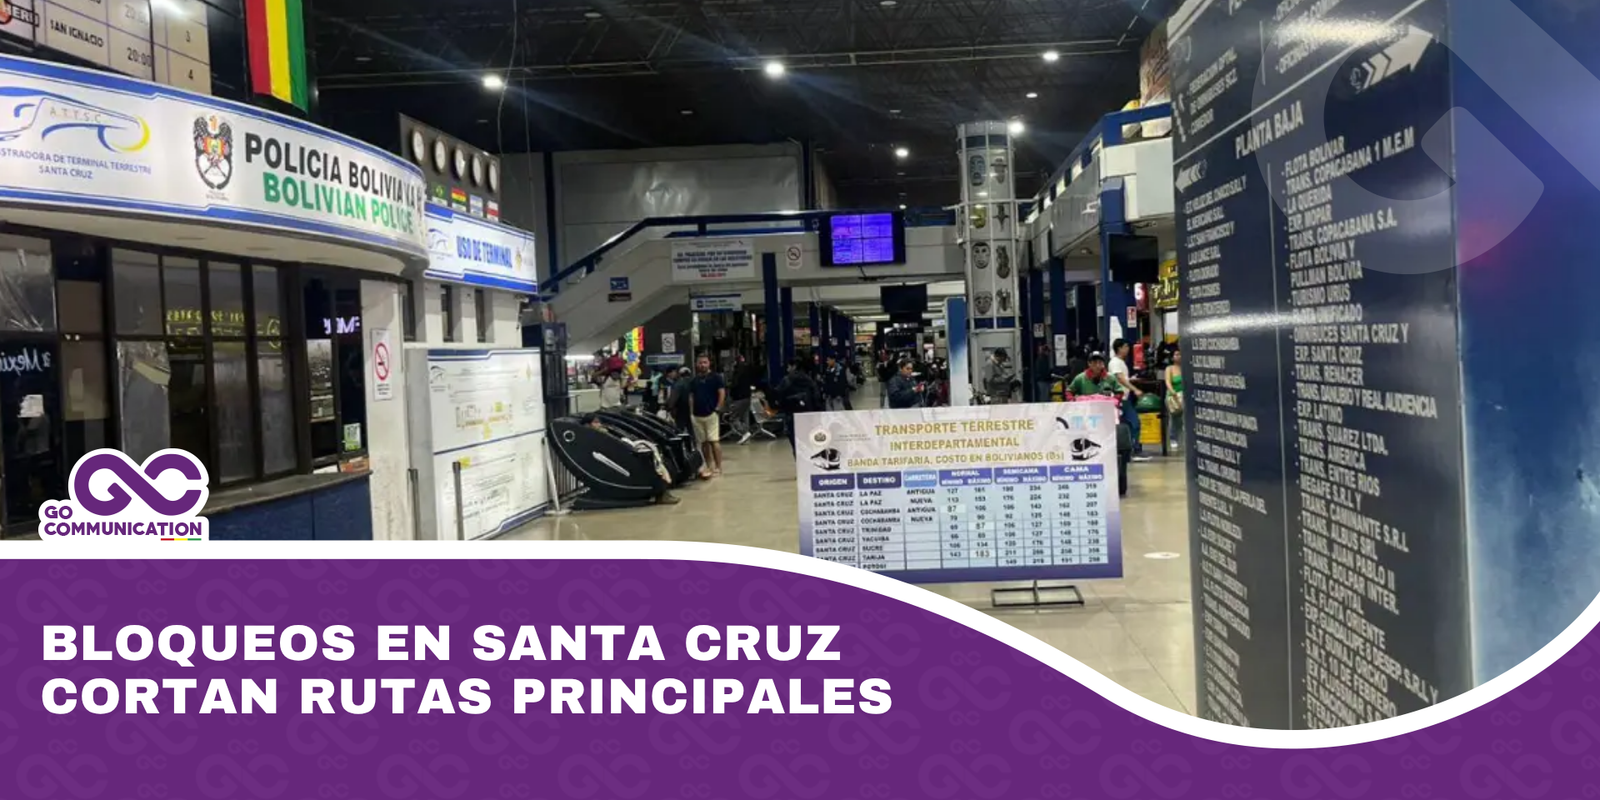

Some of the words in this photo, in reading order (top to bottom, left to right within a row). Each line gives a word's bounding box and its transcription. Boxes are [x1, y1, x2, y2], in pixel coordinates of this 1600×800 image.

[50, 19, 67, 35] SAN
[69, 26, 104, 48] IGNACIO
[188, 69, 194, 80] 4
[1235, 118, 1273, 159] PLANTA
[1273, 100, 1304, 139] BAJA
[0, 147, 51, 162] STRADORA
[53, 153, 66, 164] DE
[67, 155, 109, 170] TERMINAL
[245, 132, 342, 184] POLICIA
[1285, 153, 1308, 178] FLOTA
[1308, 135, 1345, 168] BOLIVAR
[1314, 145, 1372, 185] COPACABANA
[39, 164, 68, 176] SANTA
[69, 168, 94, 180] CRUZ
[262, 172, 367, 222] BOLIVIAN
[371, 198, 414, 235] POLICE
[1287, 196, 1297, 214] LA
[1297, 183, 1332, 212] QUERIDA
[1316, 212, 1376, 244] COPACABANA
[1376, 206, 1398, 230] S.A.
[456, 235, 471, 260] USO
[473, 239, 481, 262] DE
[482, 241, 513, 269] TERMINAL
[1289, 249, 1313, 270] FLOTA
[1313, 241, 1348, 265] BOLIVIA
[1290, 267, 1327, 288] PULLMAN
[1327, 260, 1363, 283] BOLIVIA
[1339, 324, 1370, 343] SANTA
[1371, 323, 1399, 343] CRUZ
[1400, 322, 1409, 343] Y
[1294, 345, 1311, 362] EXP.
[1311, 345, 1338, 363] SANTA
[1339, 346, 1363, 365] CRUZ
[1323, 365, 1364, 386] RENACER
[1297, 400, 1313, 418] EXP.
[1313, 402, 1343, 424] LATINO
[1321, 384, 1354, 406] DANUBIO
[1361, 388, 1384, 411] REAL
[1384, 391, 1438, 419] AUDIENCIA
[875, 422, 957, 436] TRANSPORTE
[962, 419, 1035, 431] TERRESTRE
[1326, 424, 1360, 449] SUAREZ
[1361, 431, 1389, 456] LTDA.
[890, 437, 1020, 451] INTERDEPARTAMENTAL
[1327, 443, 1367, 471] AMERICA
[847, 458, 879, 468] BANDA
[936, 455, 968, 464] COSTO
[969, 453, 983, 462] EN
[985, 451, 1044, 462] BOLIVIANOS
[818, 478, 848, 486] ORIGEN
[863, 476, 896, 485] DESTINO
[1064, 465, 1090, 473] CAMA
[1328, 463, 1357, 489] ENTRE
[1357, 472, 1380, 497] RIOS
[1329, 502, 1381, 542] CAMINANTE
[1330, 522, 1359, 551] ALBUS
[1331, 542, 1355, 569] JUAN
[1355, 553, 1386, 586] PABLO
[1303, 565, 1328, 593] FLOTA
[1328, 579, 1364, 616] CAPITAL
[1331, 561, 1366, 597] BOLPAR
[1319, 591, 1345, 622] FLOTA
[1345, 609, 1386, 650] ORIENTE
[1340, 662, 1353, 688] DE
